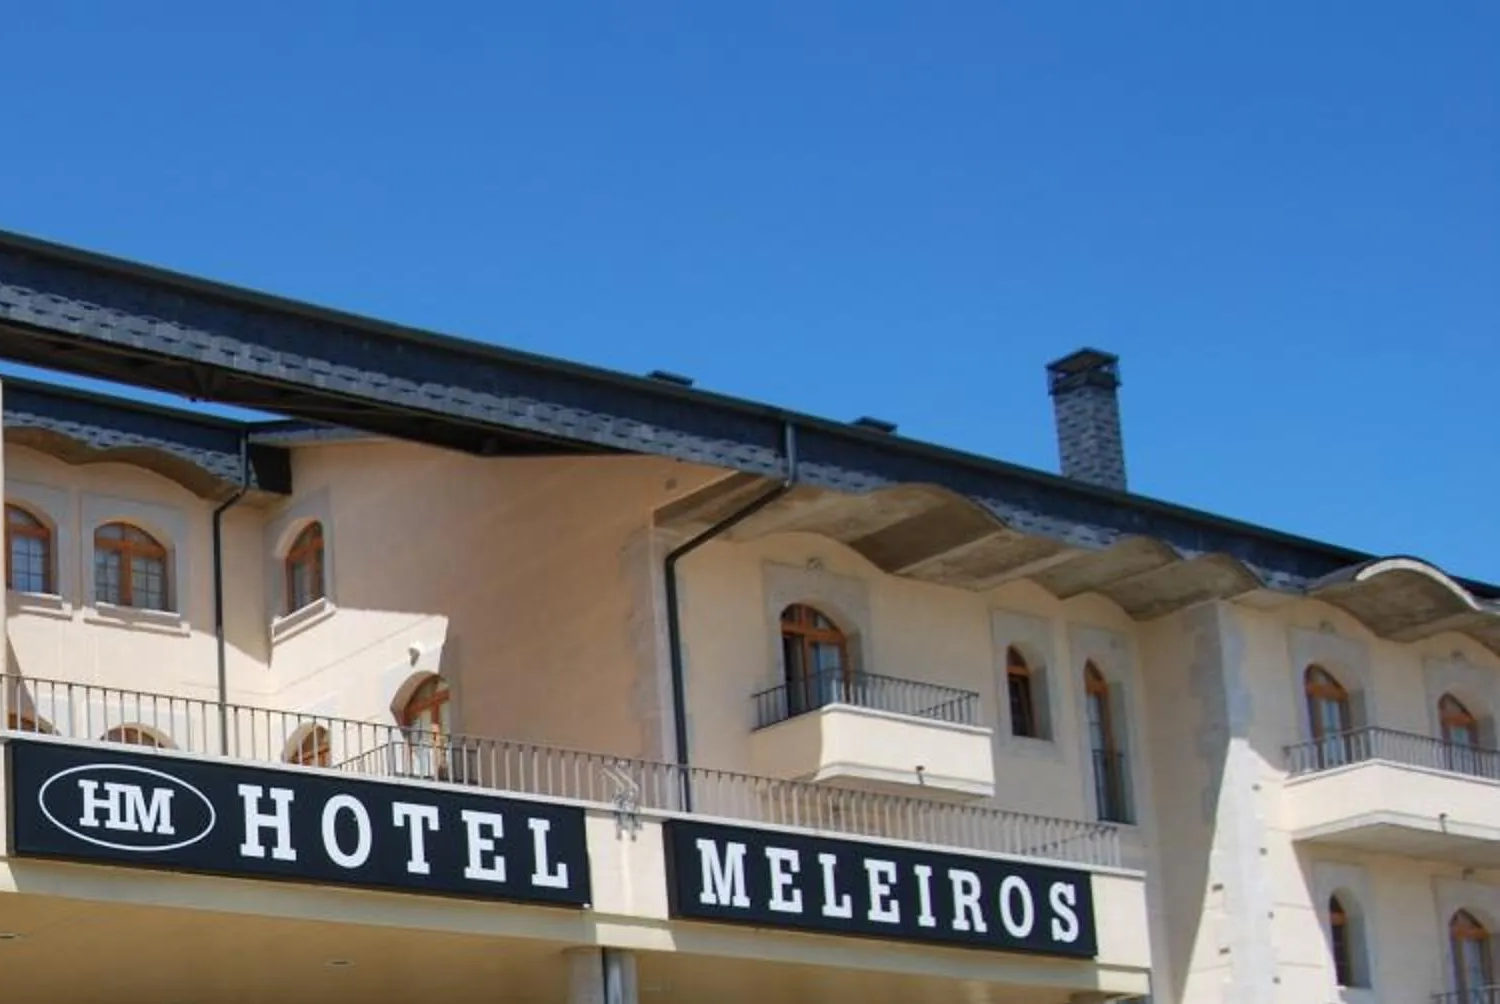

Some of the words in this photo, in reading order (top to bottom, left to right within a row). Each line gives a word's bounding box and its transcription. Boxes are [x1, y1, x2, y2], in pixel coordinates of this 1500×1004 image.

[78, 779, 175, 835] HM
[238, 783, 569, 889] HOTEL
[696, 838, 1079, 943] MELEIROS
